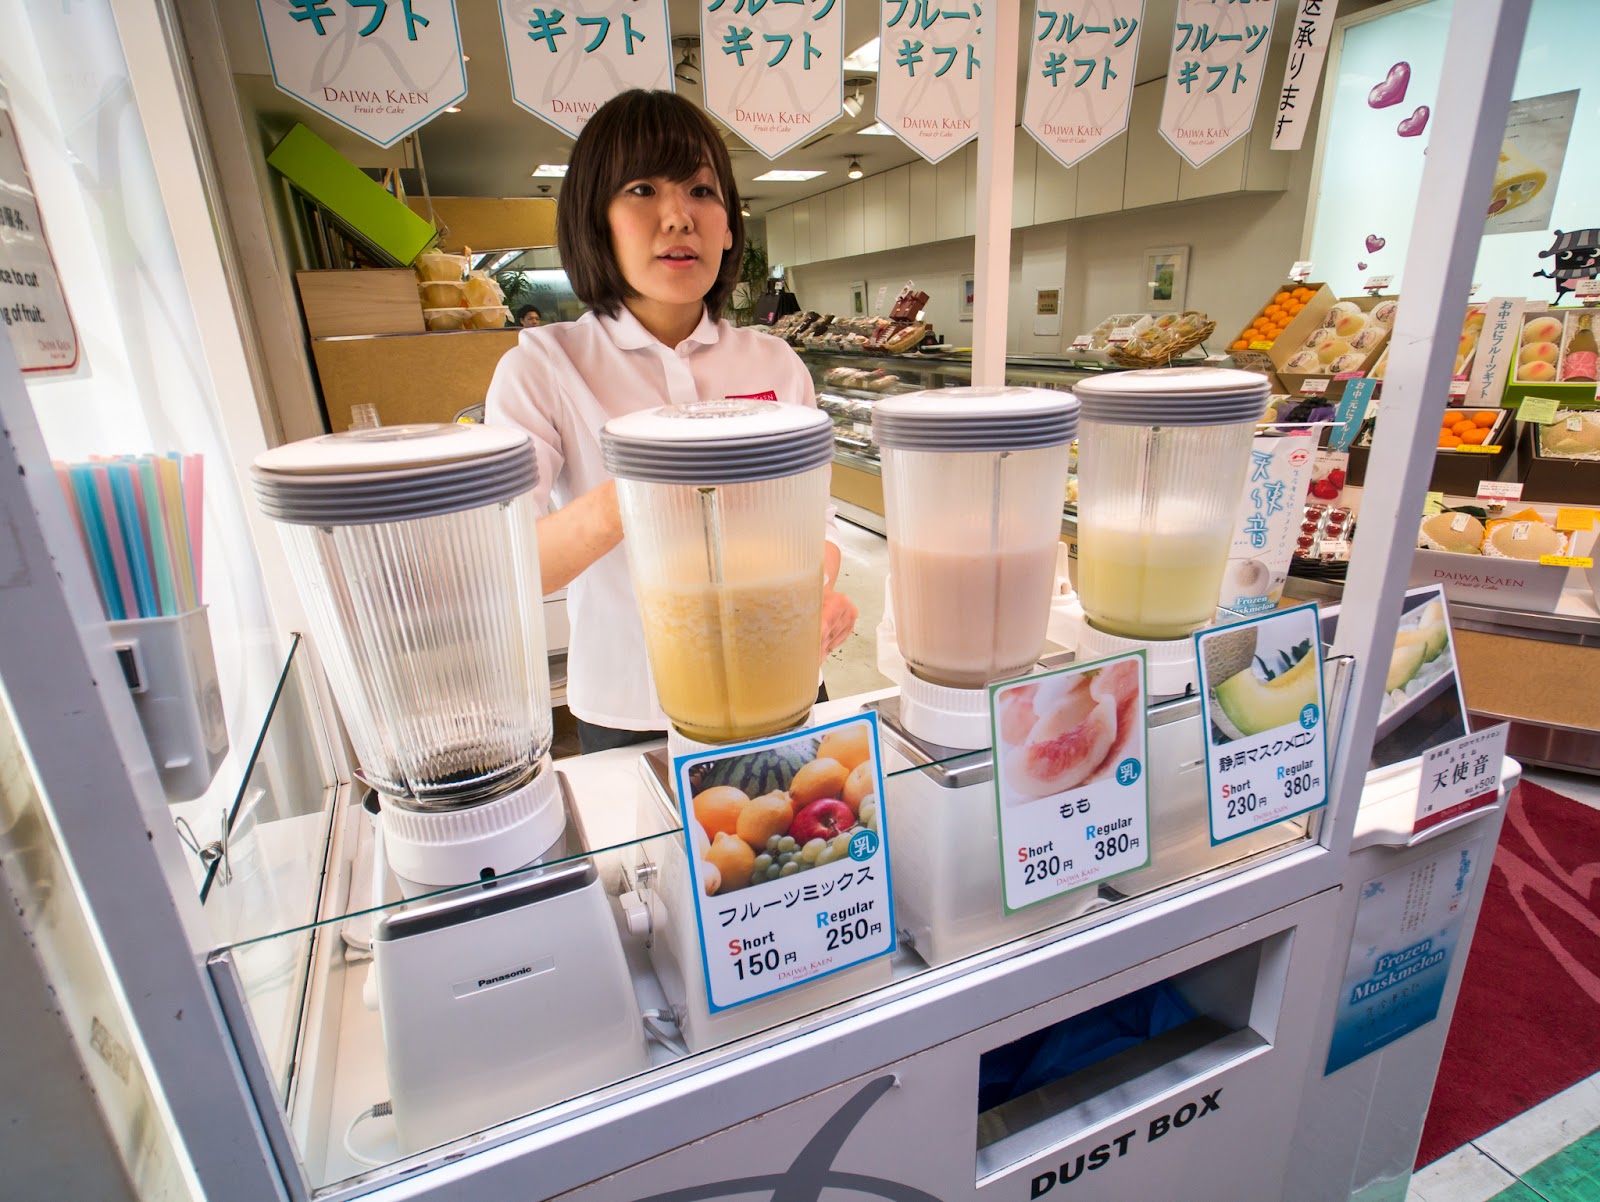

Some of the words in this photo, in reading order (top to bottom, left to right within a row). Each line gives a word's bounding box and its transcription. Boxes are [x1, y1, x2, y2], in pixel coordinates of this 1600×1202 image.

[527, 8, 646, 55] ギフト
[1038, 10, 1138, 48] フルーツ
[1175, 23, 1269, 54] フルーツ
[721, 25, 823, 71] ギフト
[896, 39, 981, 80] ギフト
[1041, 52, 1118, 90] ギフト
[1177, 61, 1247, 94] ギフト
[323, 87, 381, 103] DAIWA
[386, 89, 429, 105] KAEN
[353, 105, 374, 114] Fruit
[385, 105, 405, 114] Cake
[551, 99, 599, 113] DAIWA
[735, 109, 775, 123] DAIWA
[779, 112, 811, 124] KAEN
[903, 117, 938, 129] DAIWA
[942, 118, 971, 130] KAEN
[1043, 124, 1074, 136] DAIWA
[1077, 126, 1103, 136] KAEN
[1176, 128, 1204, 139] DAIWA
[11, 267, 24, 286] to
[24, 272, 40, 287] cut
[11, 303, 23, 322] of
[1480, 300, 1513, 399] お中元にフルーツギフト
[1433, 569, 1480, 583] DAIWA
[1485, 576, 1524, 588] KAEN
[1236, 596, 1268, 605] Frozen
[1303, 708, 1318, 726] 乳
[1219, 732, 1316, 773] 静岡マスクメロン
[1120, 763, 1138, 783] 乳
[1221, 779, 1251, 799] Short
[1277, 760, 1314, 780] Regular
[1431, 754, 1489, 794] 天使音
[1059, 798, 1091, 819] もも
[1227, 793, 1267, 819] 230円
[1284, 774, 1320, 799] 380円
[853, 834, 876, 858] 乳
[1017, 841, 1054, 863] Short
[1086, 817, 1133, 840] Regular
[1024, 855, 1073, 886] 230円
[1094, 833, 1140, 861] 380円
[718, 866, 875, 928] フルーツミックス
[728, 930, 776, 957] Short
[816, 899, 875, 929] Regular
[733, 948, 797, 981] 150円
[826, 917, 882, 951] 250円
[1376, 940, 1431, 973] Frozen
[478, 966, 532, 988] Panasonic
[778, 965, 808, 981] DAIWA
[810, 956, 833, 970] KAEN
[1351, 950, 1444, 1003] Muskmelon
[1030, 1129, 1136, 1201] DUST
[1147, 1088, 1224, 1143] BOX
